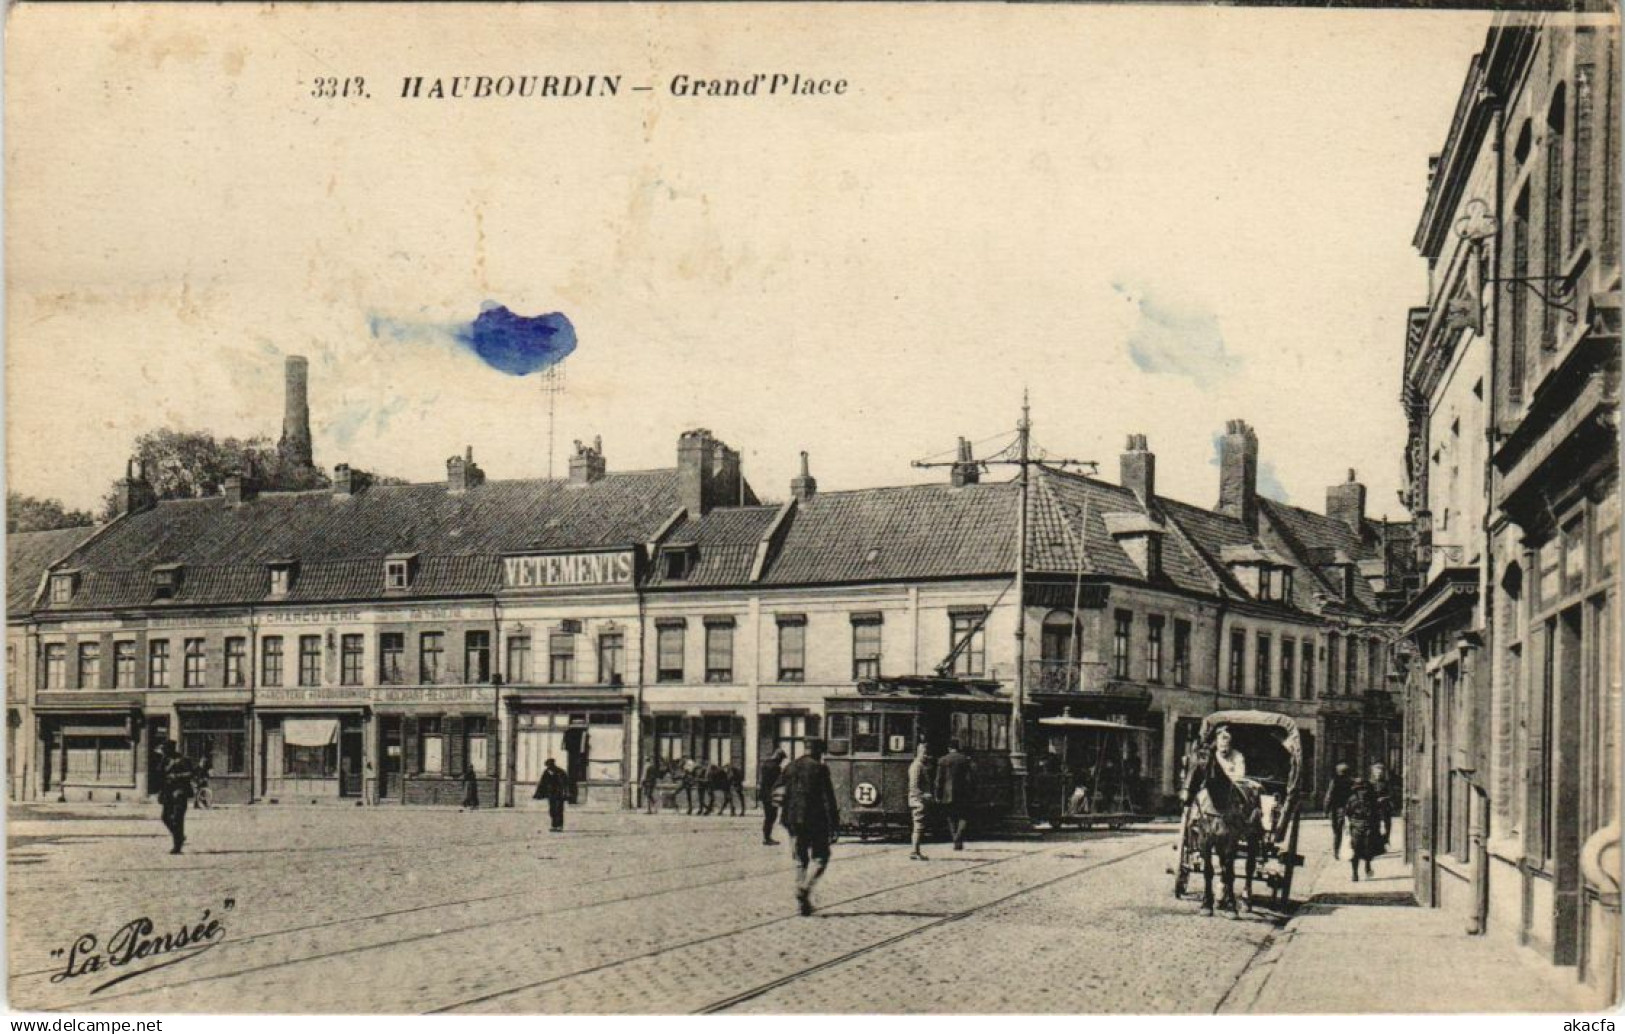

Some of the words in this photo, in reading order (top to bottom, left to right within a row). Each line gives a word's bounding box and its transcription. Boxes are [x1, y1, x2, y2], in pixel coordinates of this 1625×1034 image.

[504, 552, 632, 586] VETEMENTS
[266, 610, 361, 624] CHARCUTERIE
[859, 786, 873, 802] H
